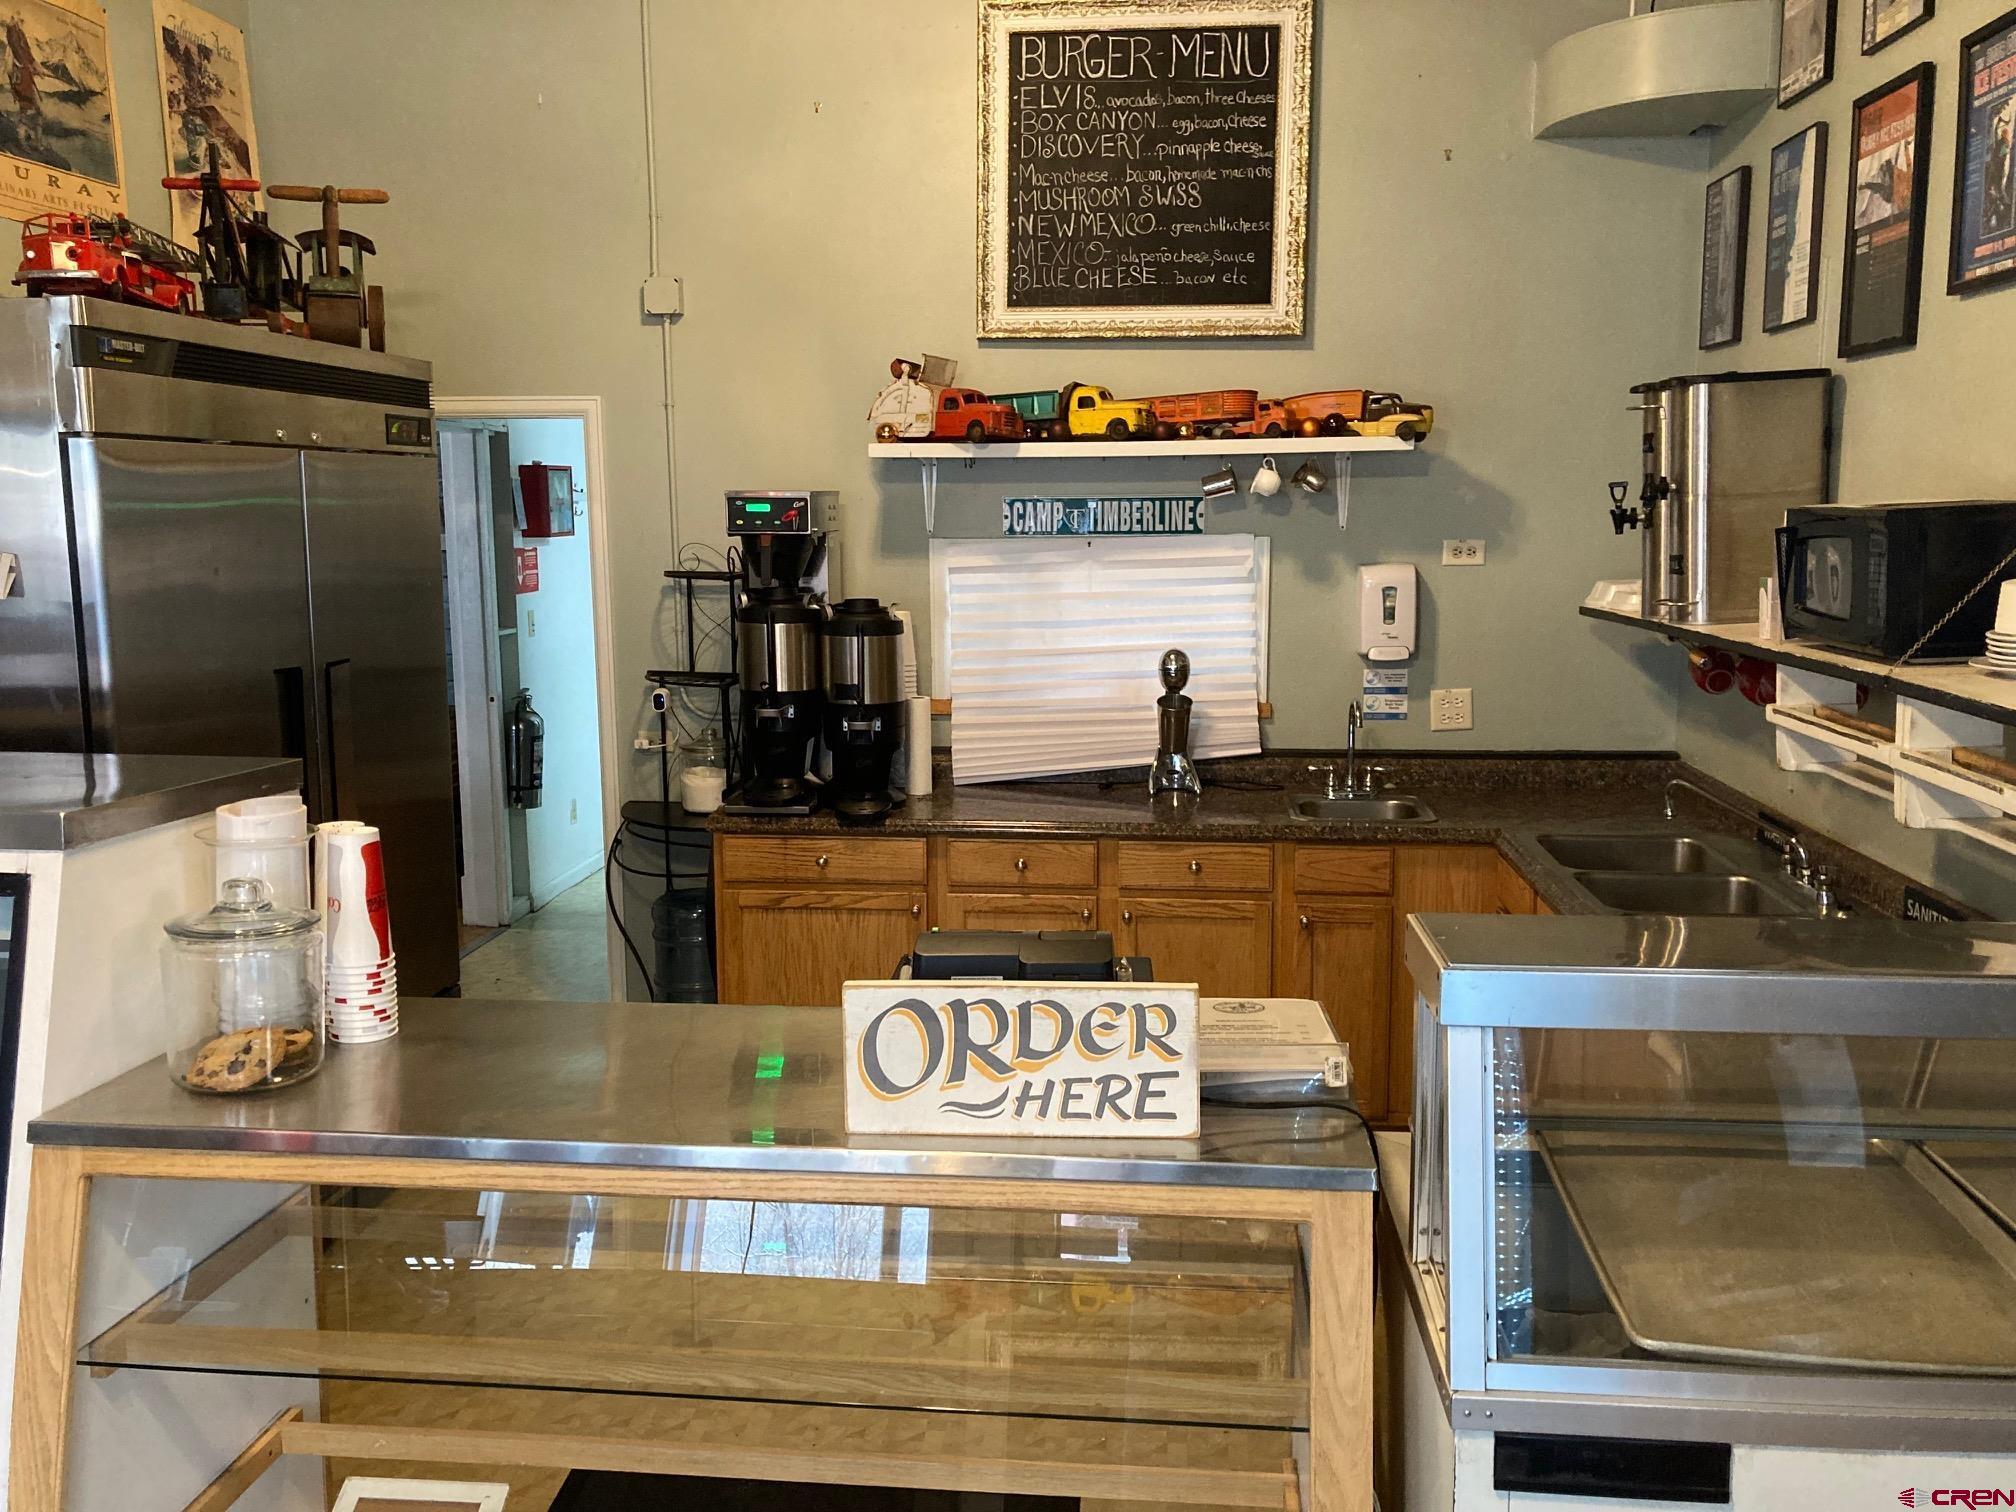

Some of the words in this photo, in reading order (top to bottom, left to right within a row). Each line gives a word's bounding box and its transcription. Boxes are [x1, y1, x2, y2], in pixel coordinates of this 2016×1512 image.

[1017, 34, 1157, 81] BURGER
[1168, 31, 1270, 78] MENU
[1205, 88, 1236, 105] three
[1021, 109, 1072, 134] BOX
[1155, 138, 1221, 161] pinnapple
[1018, 185, 1131, 213] MUSHROOM
[1013, 264, 1070, 291] BLUE
[1222, 266, 1248, 284] etc
[1013, 501, 1063, 532] CAMP
[1087, 500, 1194, 532] TIMBERLINE
[1906, 898, 1950, 923] SANITI
[857, 996, 1184, 1102] ORDER
[1012, 1070, 1180, 1121] HERE
